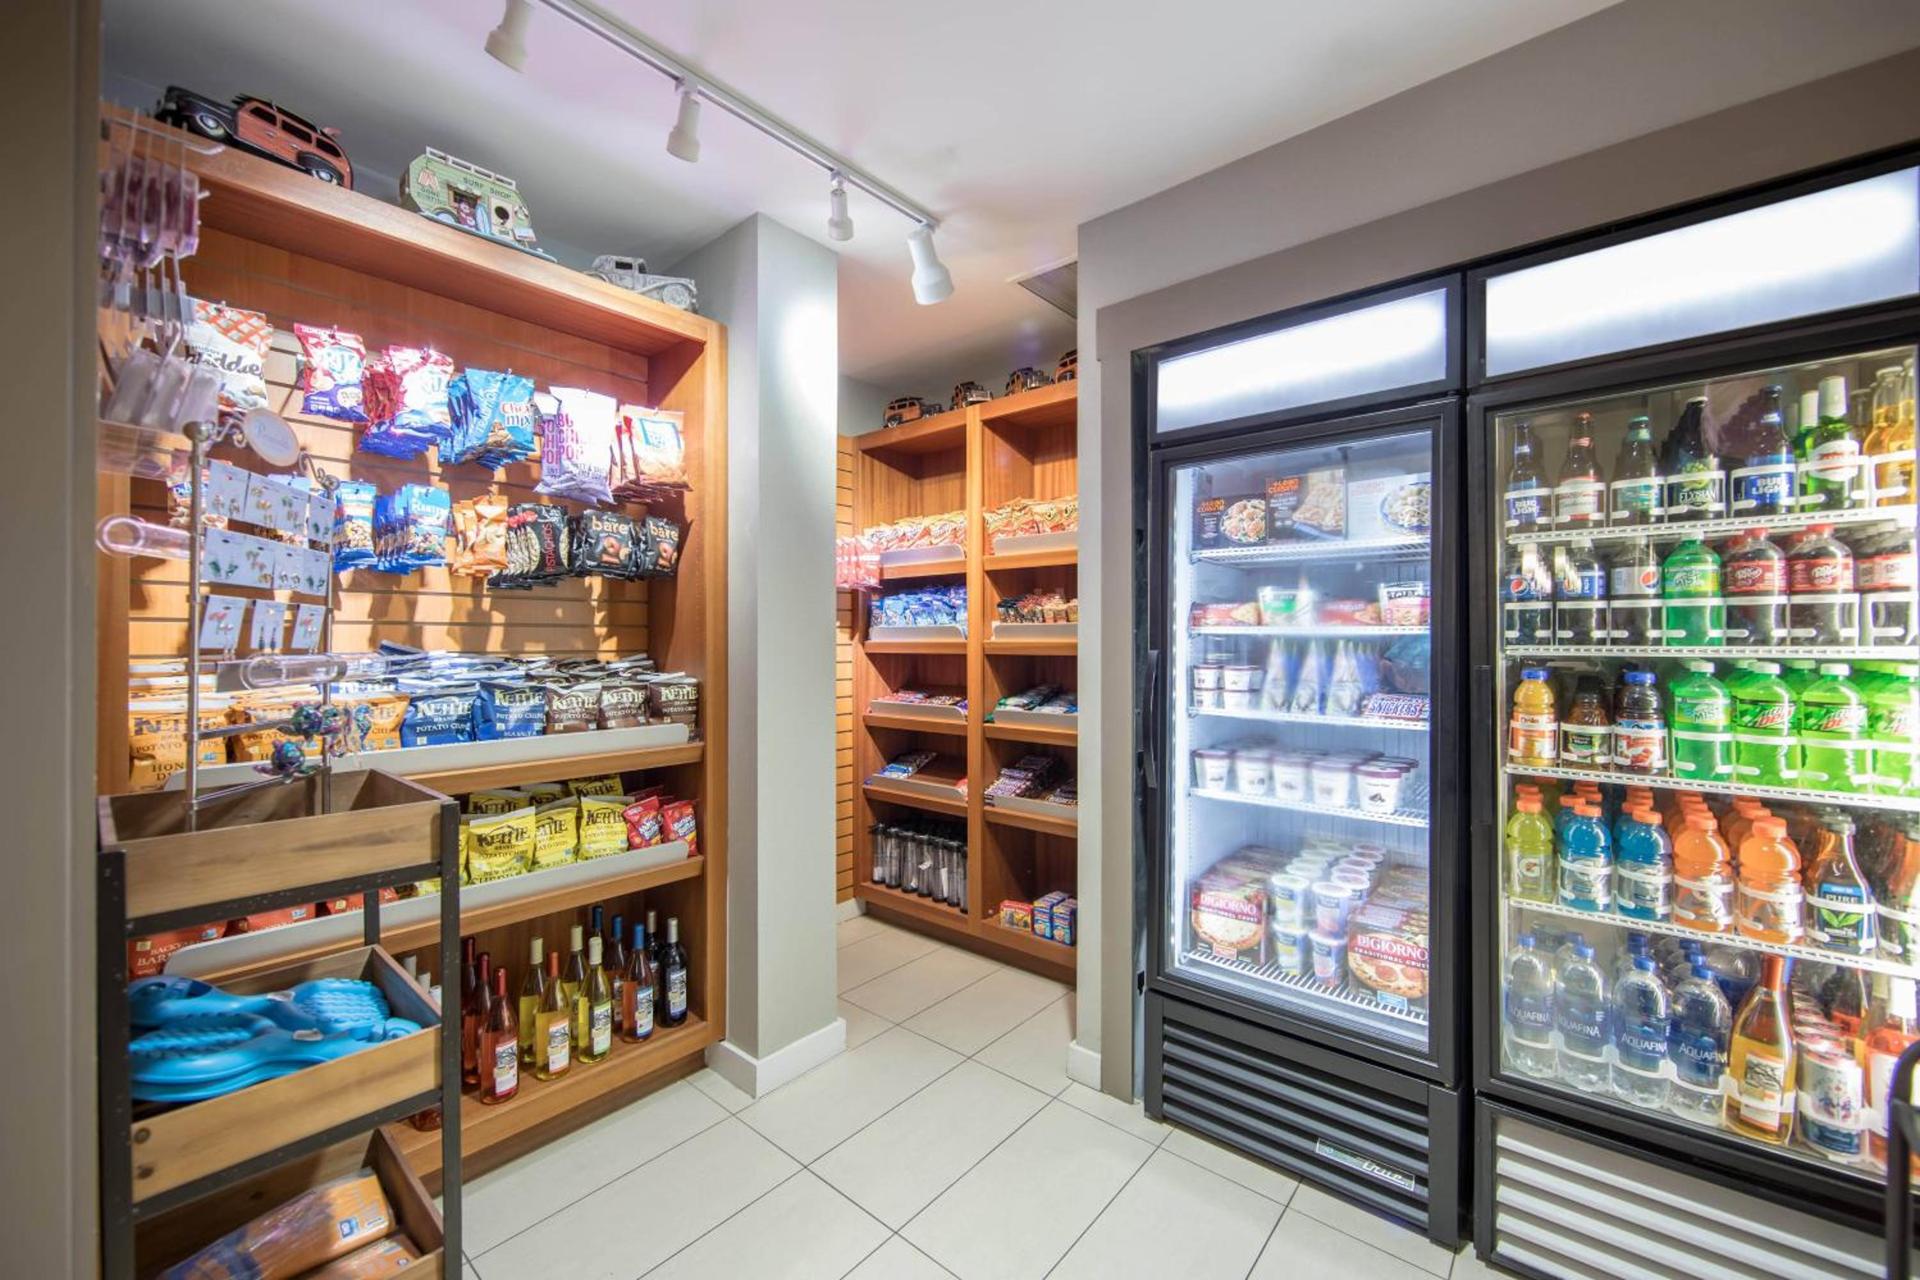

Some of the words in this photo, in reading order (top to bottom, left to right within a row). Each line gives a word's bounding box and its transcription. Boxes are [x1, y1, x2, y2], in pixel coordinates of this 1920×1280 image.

[489, 187, 512, 199] SHOP
[592, 514, 629, 535] bare
[650, 519, 680, 541] bare
[494, 687, 545, 706] KETTLE
[552, 691, 598, 711] KETTLE
[601, 687, 647, 707] KETTLE
[661, 684, 698, 701] KETTLE
[415, 702, 472, 719] KETTLE
[1370, 699, 1418, 717] SNICKERS
[416, 723, 449, 733] POTATO
[136, 742, 182, 753] POTATO
[477, 826, 532, 847] KETTLE
[1354, 947, 1404, 963] TRADITIONAL
[1357, 934, 1428, 961] DIGIORNO
[1620, 1032, 1669, 1053] AQUAFIN
